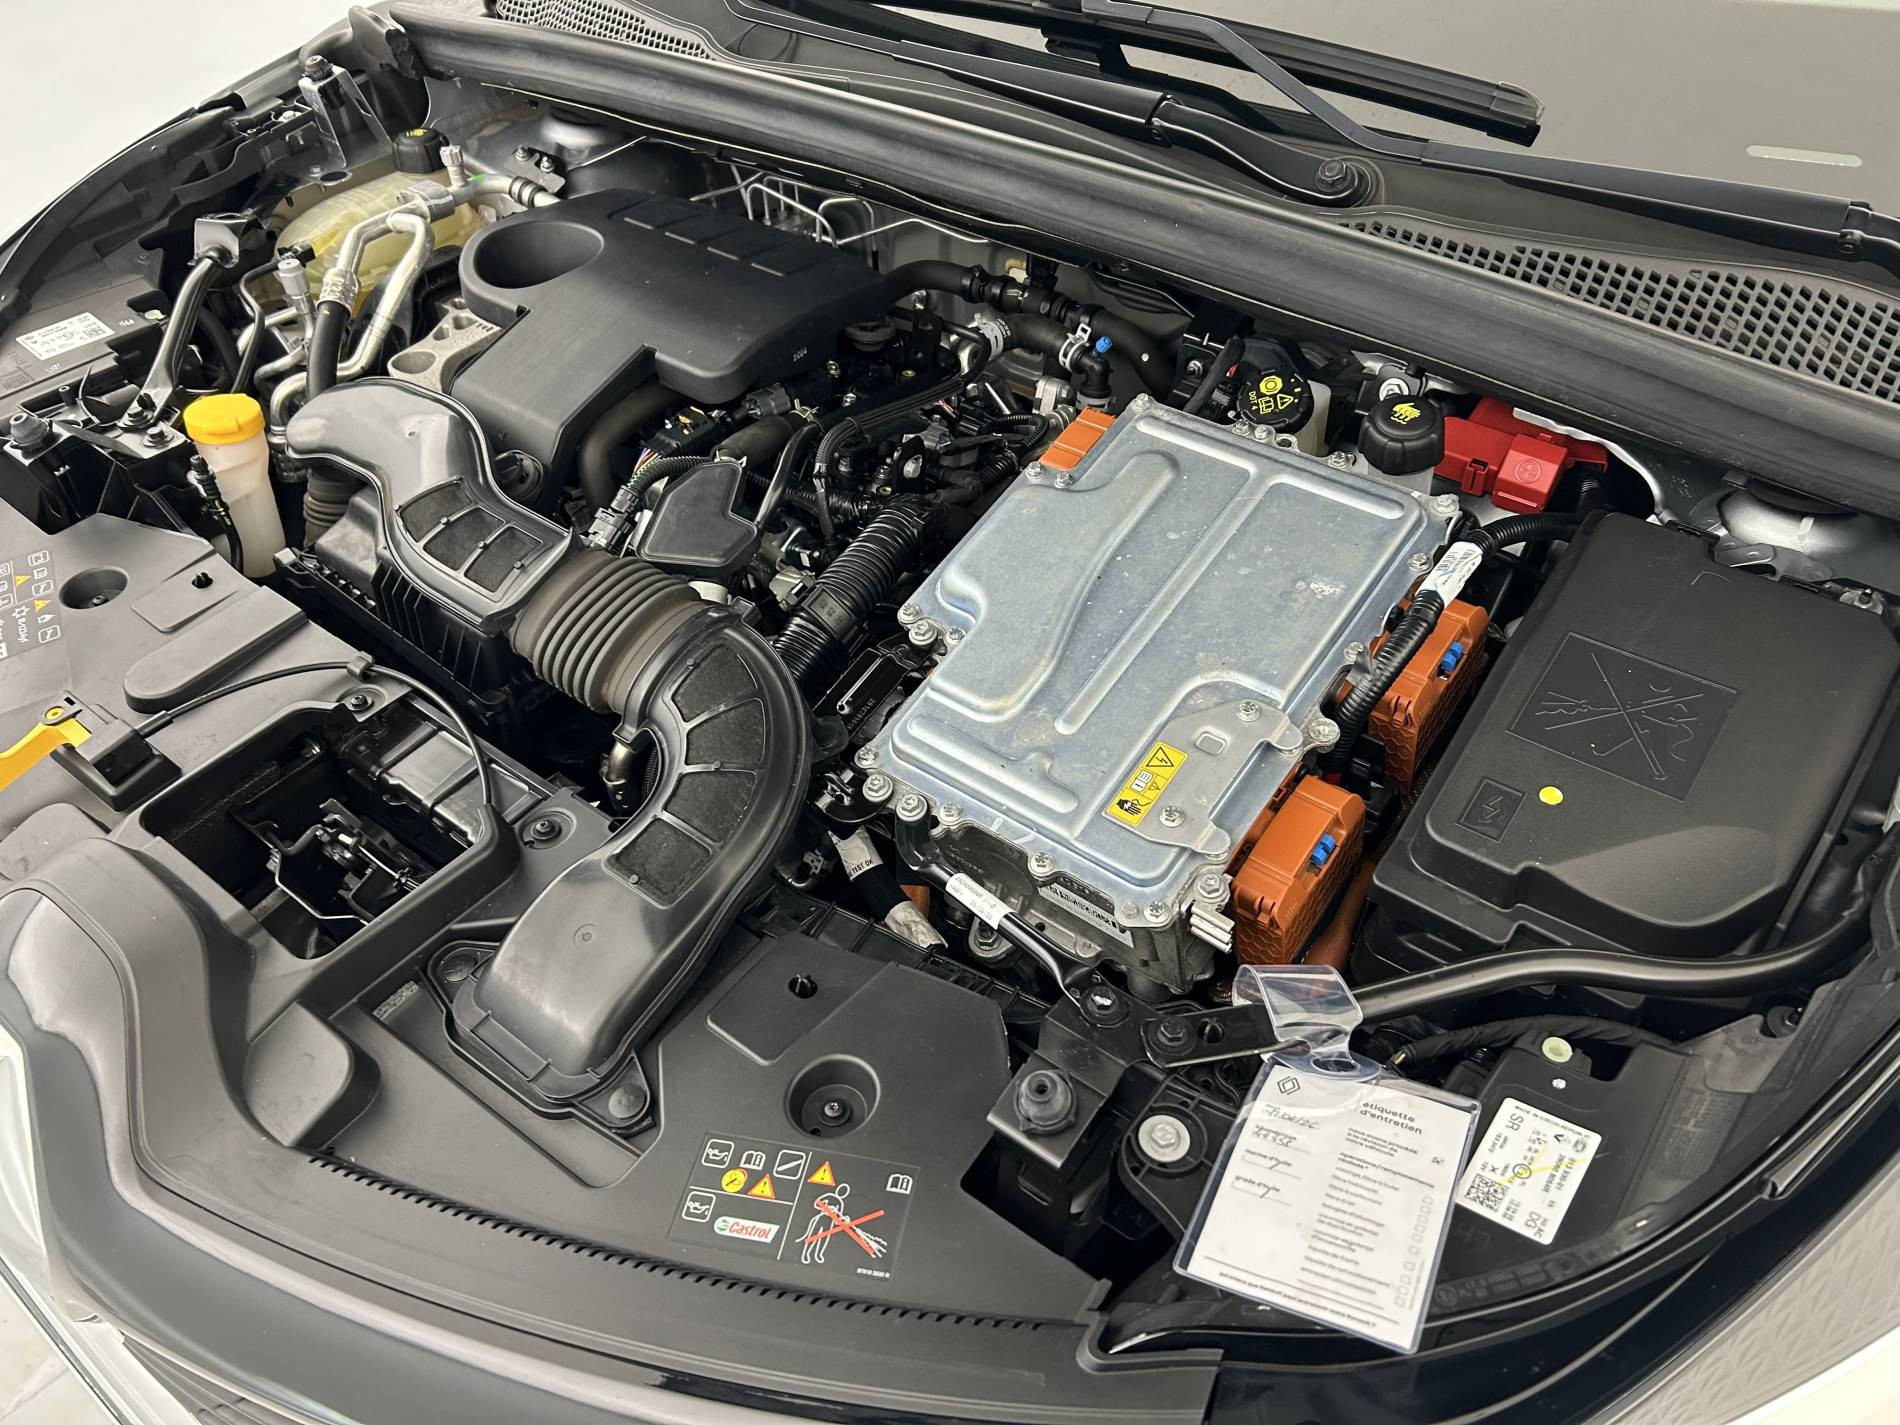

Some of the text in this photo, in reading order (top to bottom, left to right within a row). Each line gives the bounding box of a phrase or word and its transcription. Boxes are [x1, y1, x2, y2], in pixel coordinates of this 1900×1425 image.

[1249, 391, 1258, 404] DOT
[1360, 1109, 1422, 1134] d'entretien
[1505, 1113, 1524, 1131] SR
[1525, 1211, 1541, 1229] DG
[729, 1221, 772, 1239] Castrol
